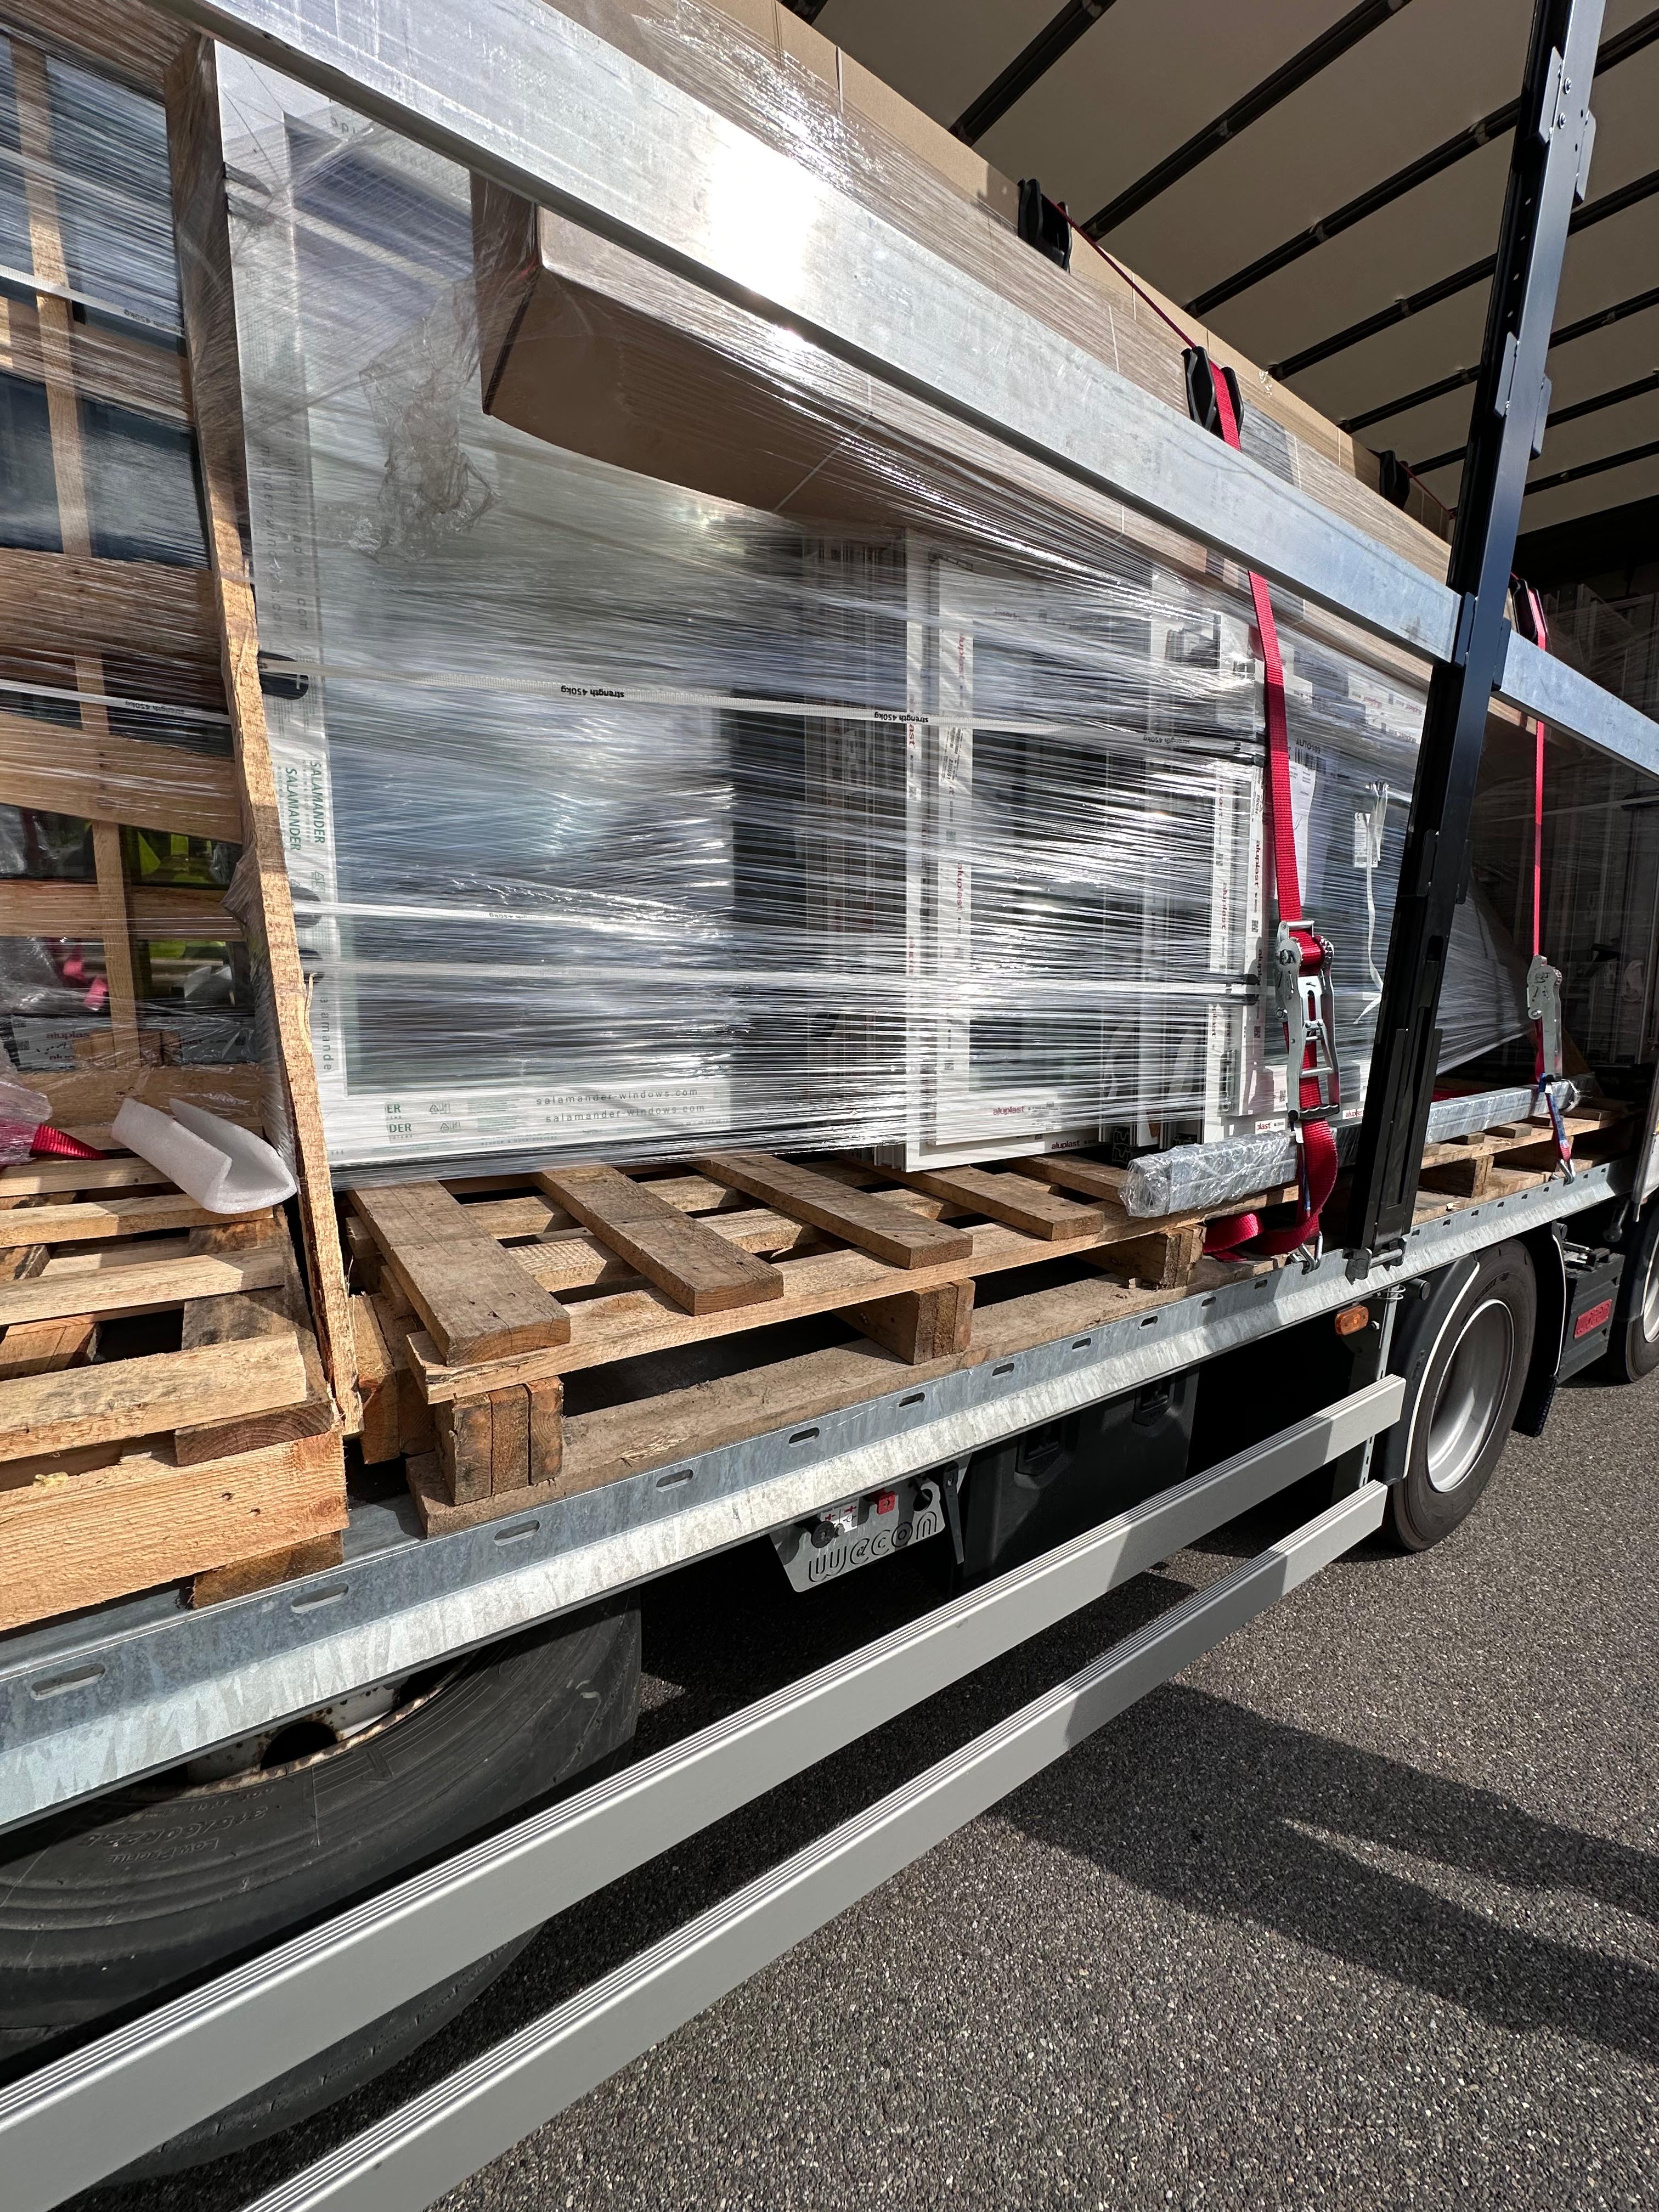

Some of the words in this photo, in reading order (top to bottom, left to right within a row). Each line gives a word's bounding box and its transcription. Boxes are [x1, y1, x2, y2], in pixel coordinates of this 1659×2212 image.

[561, 685, 588, 696] 450kg
[590, 689, 624, 698] strength
[874, 711, 897, 721] 450kg
[899, 714, 929, 723] strength
[311, 760, 325, 843] SALAMANDER
[285, 767, 301, 851] SALAMANDER
[536, 1088, 698, 1105] salamander-windows.com
[545, 1104, 705, 1123] salamander-windows.com
[1051, 1140, 1080, 1149] aluplast
